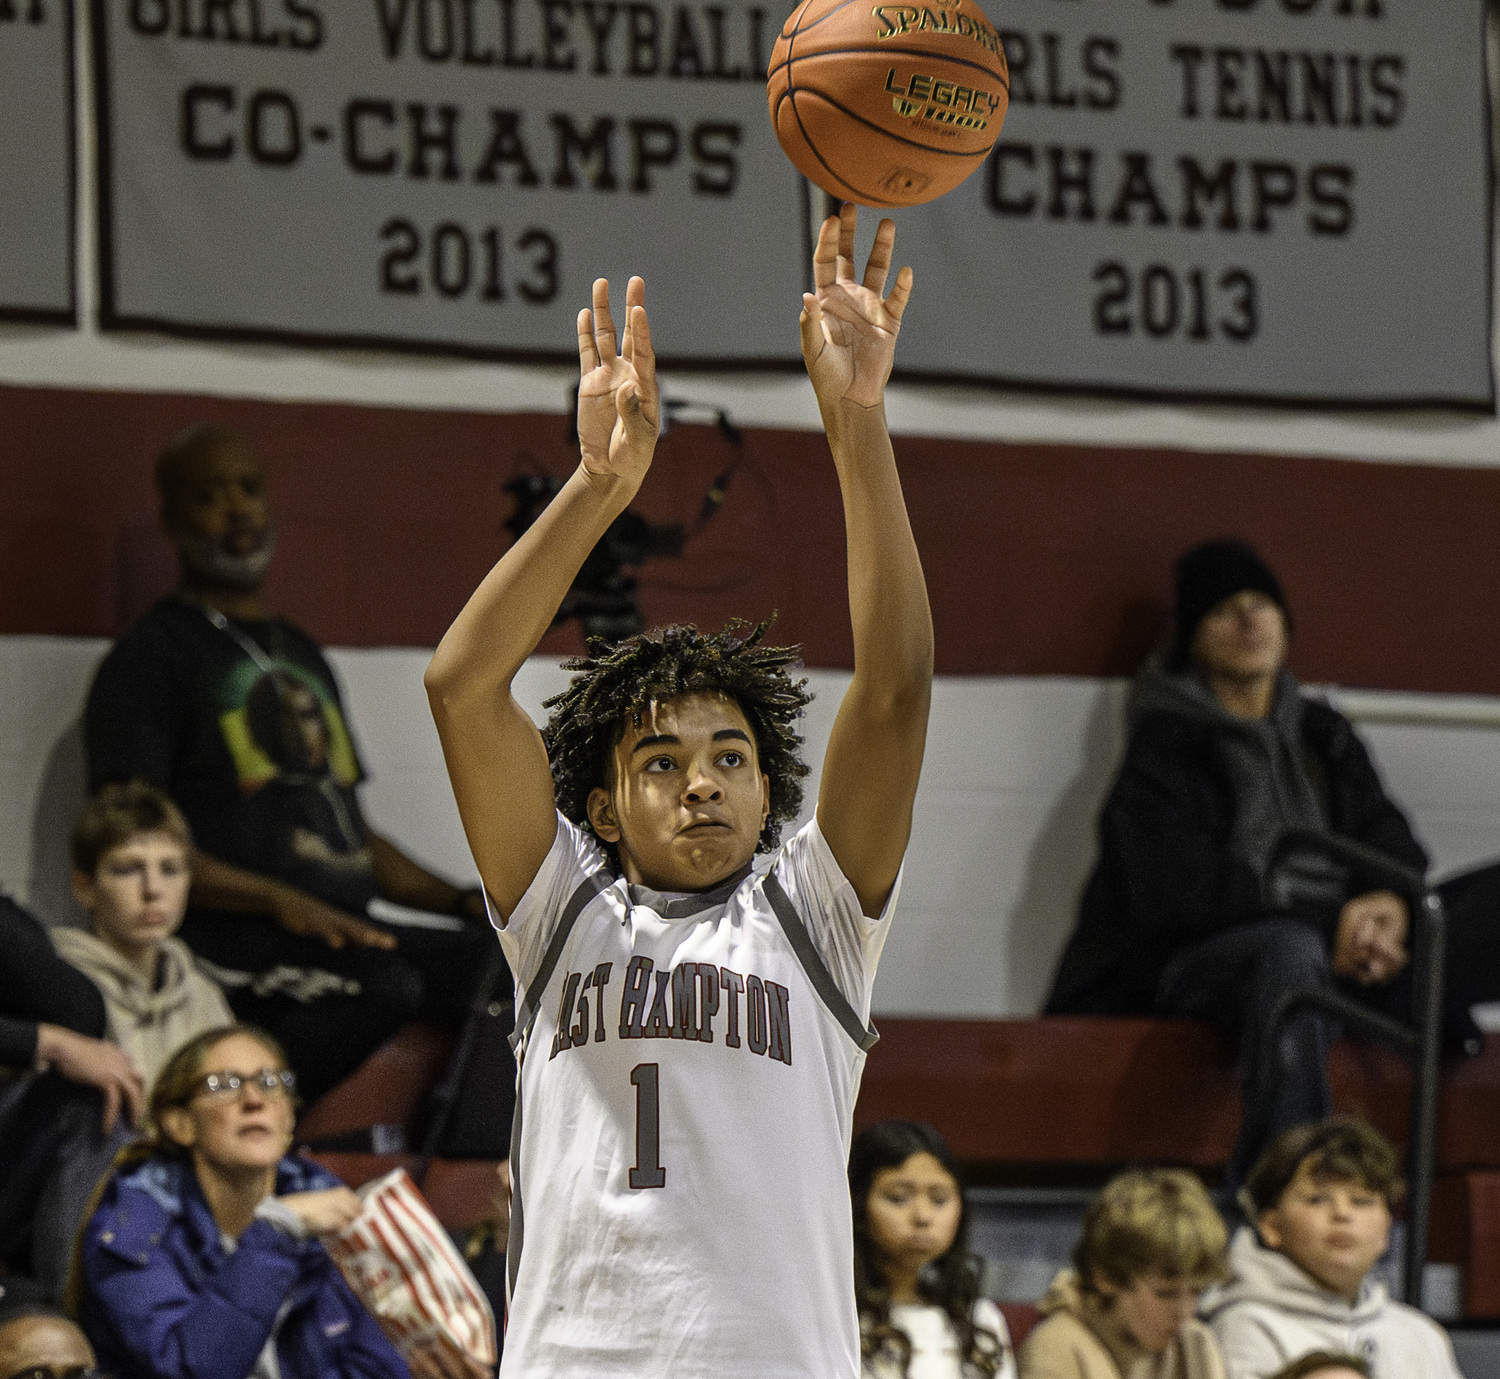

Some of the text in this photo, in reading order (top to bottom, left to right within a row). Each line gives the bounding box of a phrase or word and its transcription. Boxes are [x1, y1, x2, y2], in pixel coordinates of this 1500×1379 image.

[884, 67, 999, 118] LEGACY
[998, 28, 1404, 127] RLS TENNIS
[182, 82, 744, 198] CO-CHAMPS
[984, 140, 1356, 238] CHAMPS
[380, 218, 560, 306] 2013
[1093, 260, 1259, 344] 2013
[549, 955, 792, 1066] AST HAMPTON
[629, 1063, 666, 1189] 1
